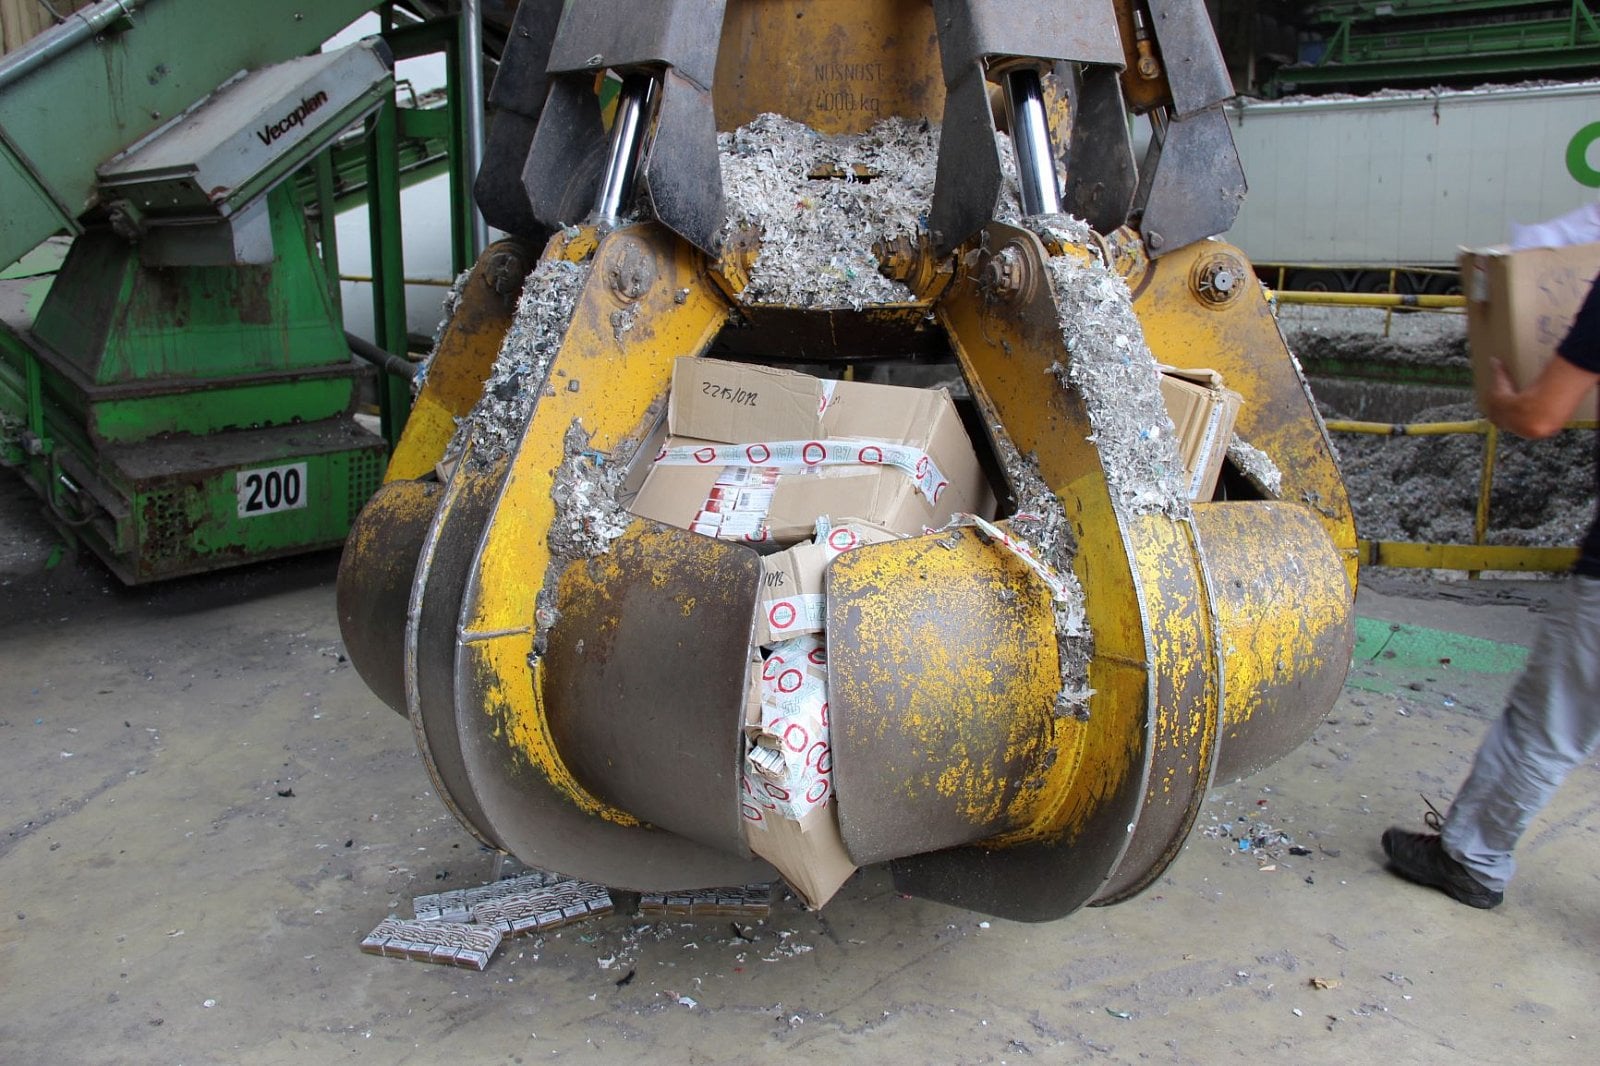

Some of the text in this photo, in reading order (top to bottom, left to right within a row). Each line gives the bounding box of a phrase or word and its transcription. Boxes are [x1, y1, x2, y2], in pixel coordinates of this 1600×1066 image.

[256, 90, 328, 146] Vecoplan
[815, 90, 854, 111] 4000
[245, 468, 300, 512] 200
